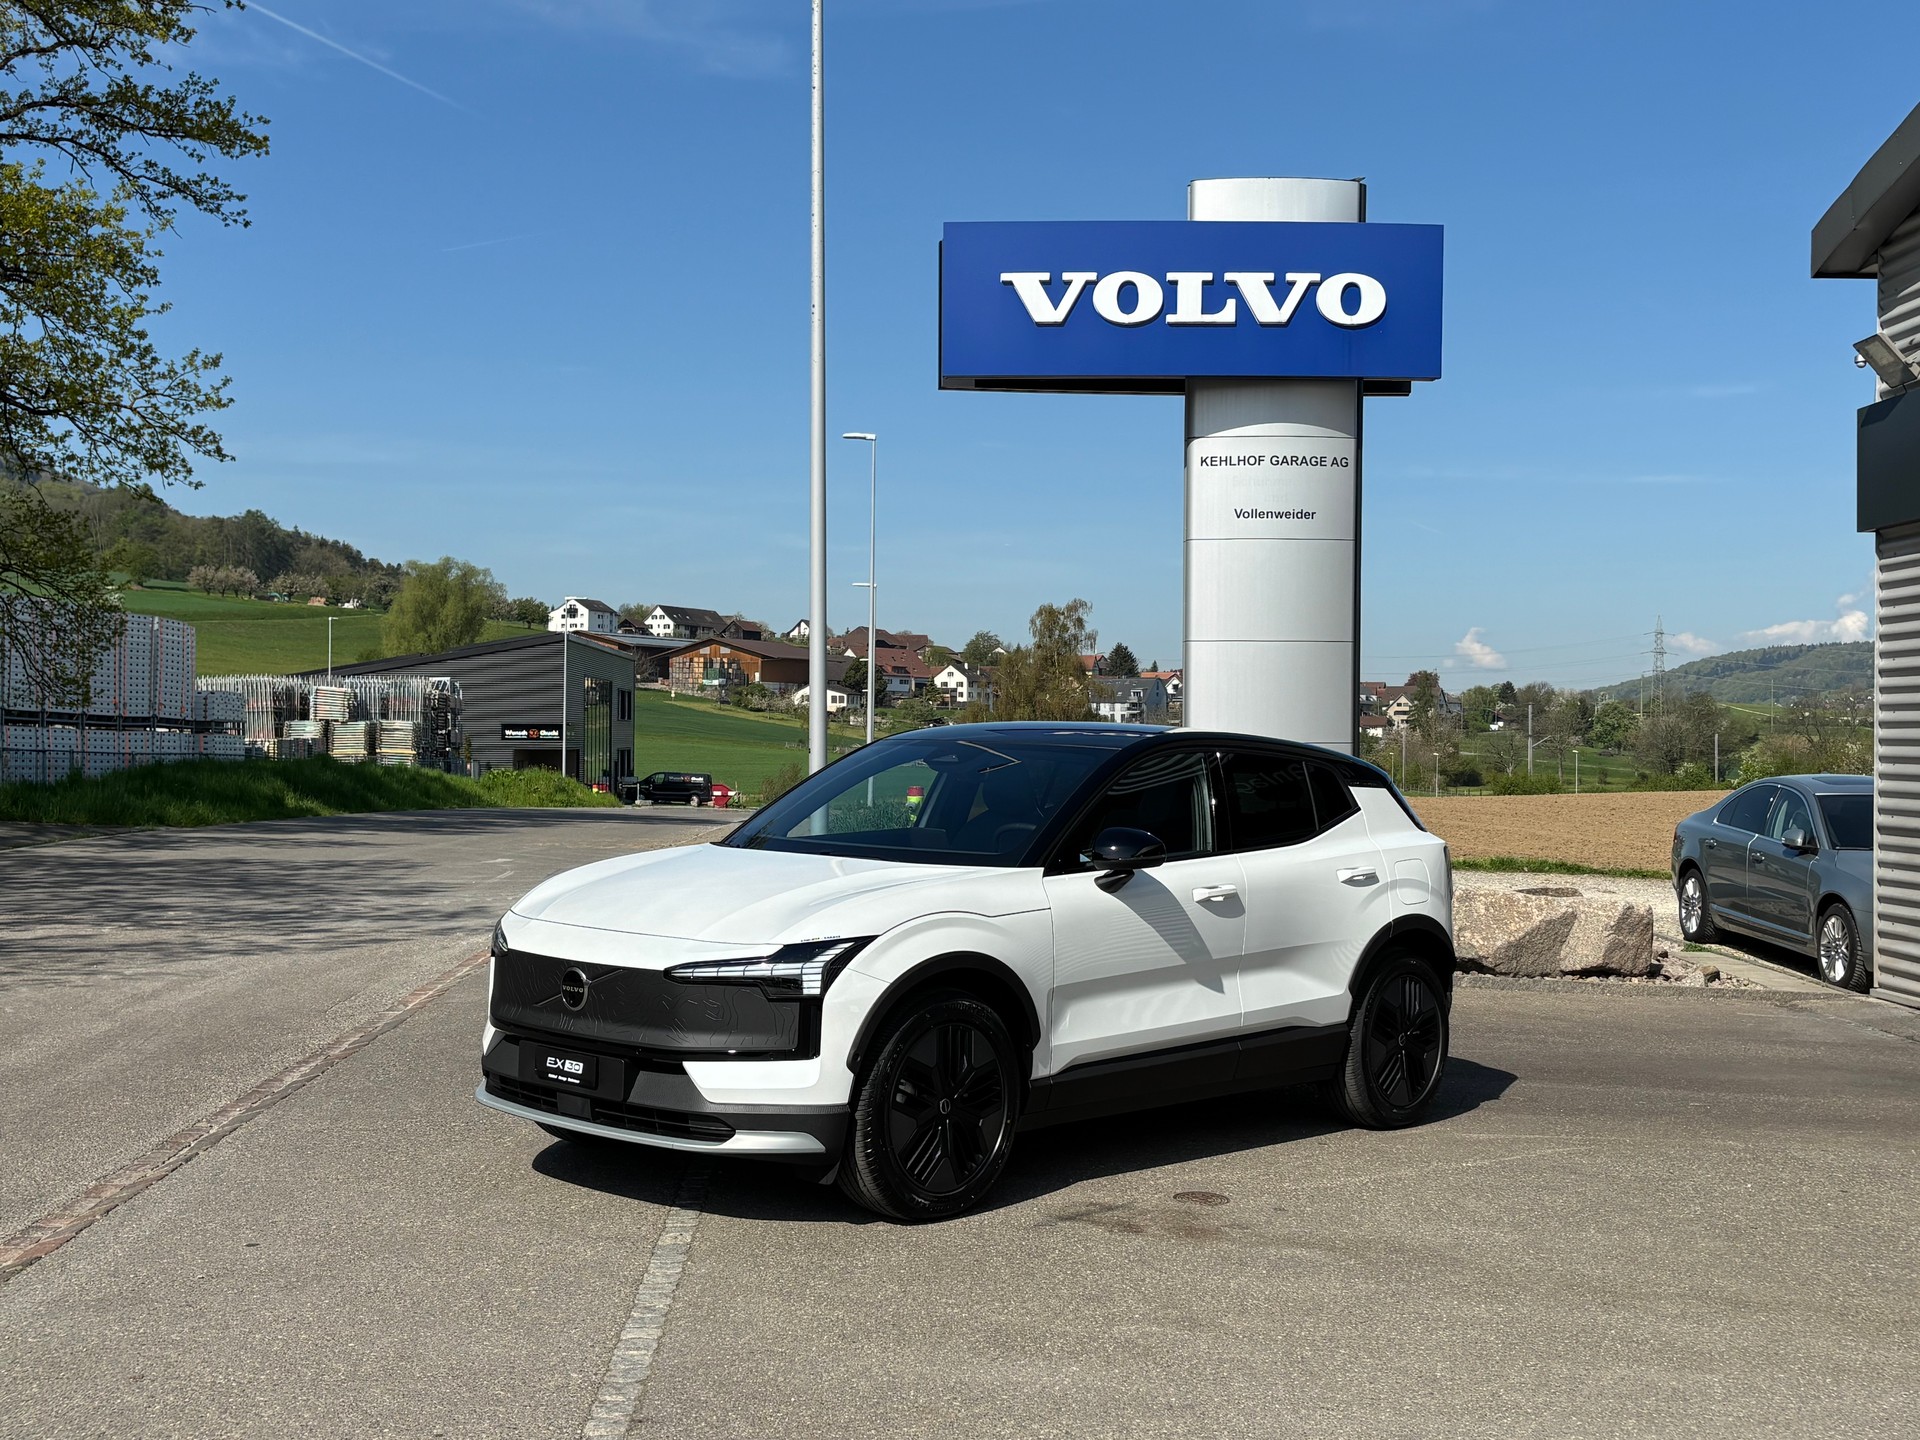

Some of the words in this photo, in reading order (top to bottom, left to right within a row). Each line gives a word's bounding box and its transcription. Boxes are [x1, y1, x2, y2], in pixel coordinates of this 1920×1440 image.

[1000, 271, 1387, 327] VOLVO
[1200, 455, 1265, 467] KEHLHOF
[1269, 455, 1328, 467] GARAGE
[1330, 456, 1349, 468] AG
[1233, 508, 1317, 520] Vollenweider
[562, 985, 584, 993] VOLVO
